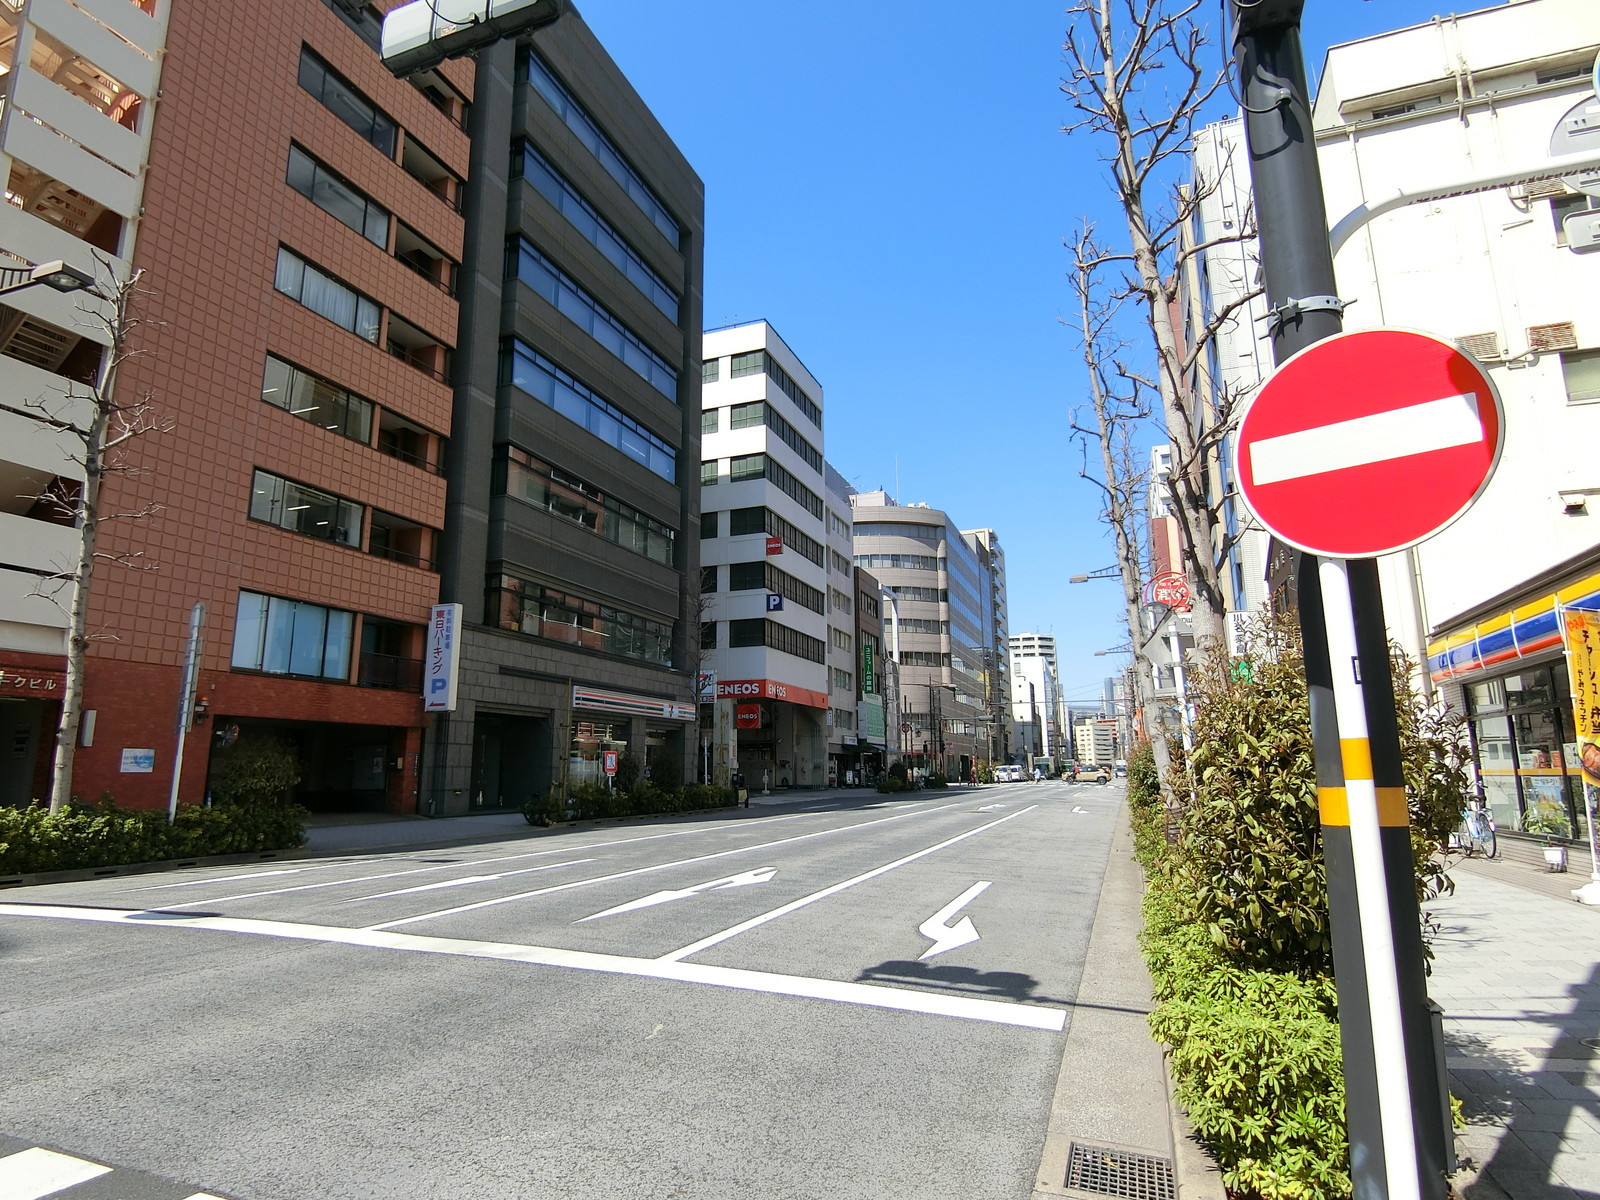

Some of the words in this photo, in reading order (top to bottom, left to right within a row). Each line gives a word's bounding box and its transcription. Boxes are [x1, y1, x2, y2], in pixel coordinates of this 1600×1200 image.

[769, 595, 780, 610] P
[432, 609, 446, 675] 東日パーキング
[431, 678, 447, 694] P
[717, 683, 760, 695] ENEOS
[768, 684, 787, 697] ENEOS
